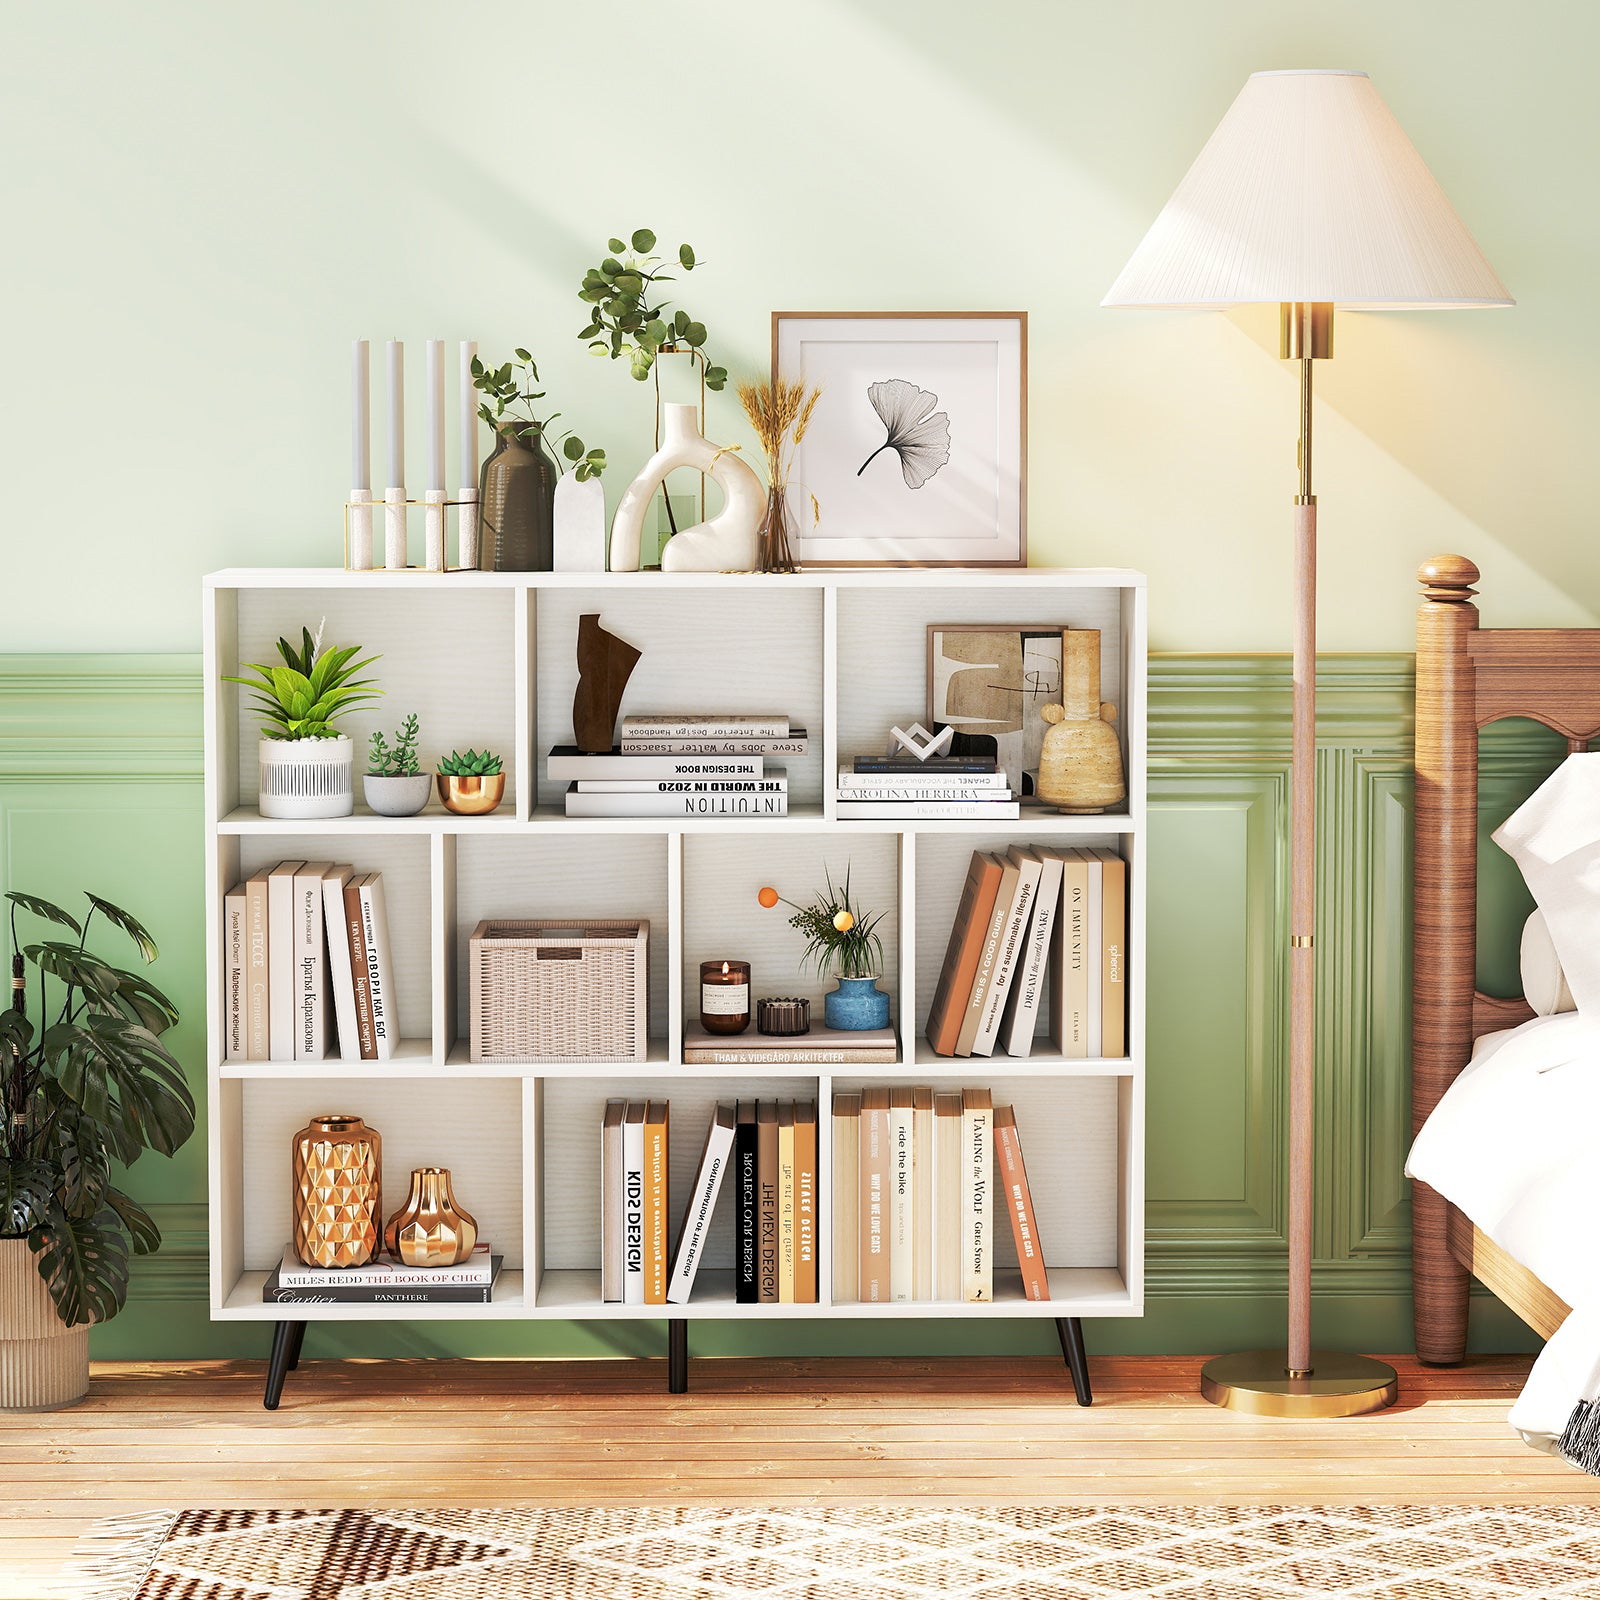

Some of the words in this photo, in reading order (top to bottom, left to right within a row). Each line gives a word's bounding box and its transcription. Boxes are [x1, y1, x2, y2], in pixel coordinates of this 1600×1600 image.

[676, 727, 707, 735] Design
[623, 744, 673, 752] Isaacson
[680, 743, 717, 752] Walter
[723, 743, 735, 752] by
[742, 744, 765, 752] Jobs
[773, 744, 803, 752] Steve
[675, 765, 701, 773] BOOK
[702, 765, 736, 773] DESIGN
[738, 765, 754, 773] THE
[658, 783, 691, 791] 2020
[694, 783, 708, 791] IN
[711, 783, 754, 791] WORLD
[759, 783, 782, 791] THE
[839, 790, 910, 799] CAROLINA
[915, 790, 978, 799] HERRERA
[685, 798, 781, 813] INTUITION
[1015, 884, 1030, 916] lifestyle
[1073, 888, 1081, 903] ON
[993, 910, 1005, 938] GUIDE
[1004, 917, 1021, 965] sustainable
[1072, 909, 1081, 970] IMMUNITY
[252, 932, 264, 968] ГЕССЕ
[985, 940, 996, 968] GOOD
[1024, 974, 1037, 1008] DREAM
[1031, 962, 1039, 973] the
[1036, 909, 1049, 944] AWAKE
[367, 948, 381, 995] ГОВОРИ
[1002, 965, 1008, 973] a
[1108, 945, 1122, 983] spherical
[301, 957, 316, 991] Братья
[982, 969, 988, 977] A
[996, 972, 1006, 986] for
[232, 967, 241, 1012] Маленькие
[979, 978, 986, 987] IS
[356, 976, 369, 1022] Бархатная
[973, 987, 984, 1007] THIS
[373, 998, 384, 1018] КАК
[231, 1012, 240, 1051] женщины
[301, 993, 316, 1053] Карамазовы
[375, 1021, 386, 1039] БОГ
[360, 1022, 372, 1053] смерть
[714, 1053, 738, 1062] THAM
[739, 1053, 747, 1062] &
[748, 1052, 790, 1062] VIDEGÅRD
[793, 1053, 844, 1062] ARKITEKTER
[898, 1126, 906, 1147] ride
[973, 1115, 986, 1163] TAMING
[898, 1151, 906, 1169] the
[973, 1166, 983, 1179] the
[871, 1173, 880, 1190] WHY
[898, 1172, 907, 1195] bike
[871, 1191, 880, 1202] DO
[973, 1180, 986, 1214] WOLF
[1012, 1184, 1023, 1200] WHY
[871, 1203, 880, 1215] WE
[1015, 1201, 1025, 1211] DO
[871, 1216, 880, 1234] LOVE
[1017, 1211, 1027, 1223] WE
[974, 1221, 983, 1246] GREG
[1019, 1223, 1030, 1240] LOVE
[871, 1235, 880, 1254] CATS
[1023, 1240, 1034, 1258] CATS
[974, 1247, 983, 1274] STONE
[287, 1276, 325, 1285] MILES
[328, 1276, 362, 1284] REDD
[365, 1275, 392, 1283] THE
[395, 1275, 428, 1283] BOOK
[432, 1275, 449, 1283] OF
[452, 1274, 482, 1283] CHIC
[272, 1288, 337, 1303] Cartier
